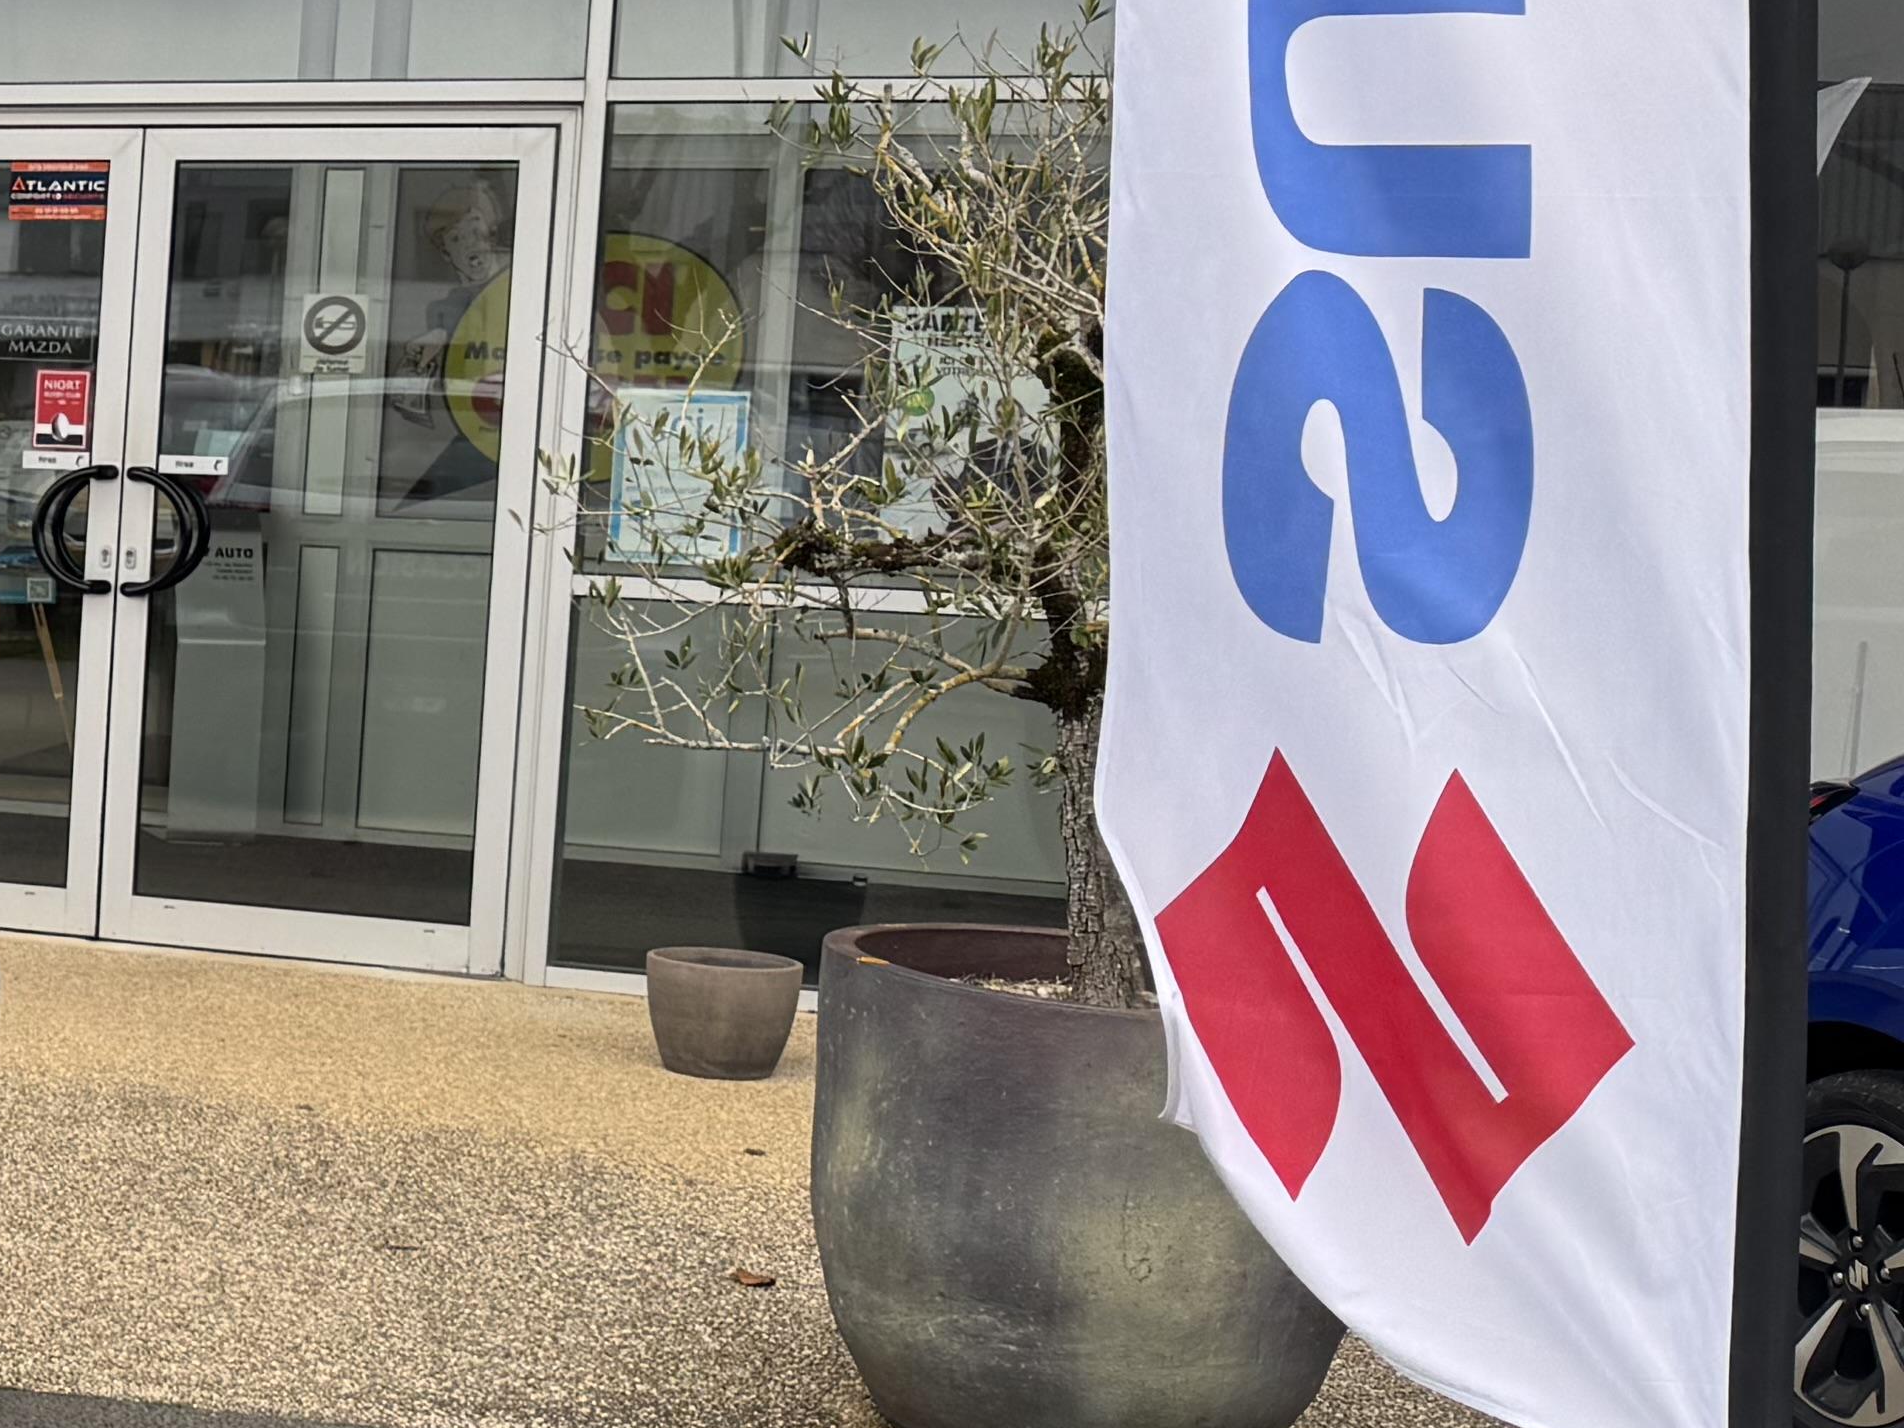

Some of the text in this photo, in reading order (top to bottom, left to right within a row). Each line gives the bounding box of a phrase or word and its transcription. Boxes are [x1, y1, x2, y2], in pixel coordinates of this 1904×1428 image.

[11, 176, 106, 192] ATLANTIC
[1, 324, 82, 339] GARANTIE
[8, 340, 73, 355] MAZDA
[215, 547, 254, 559] AUTO
